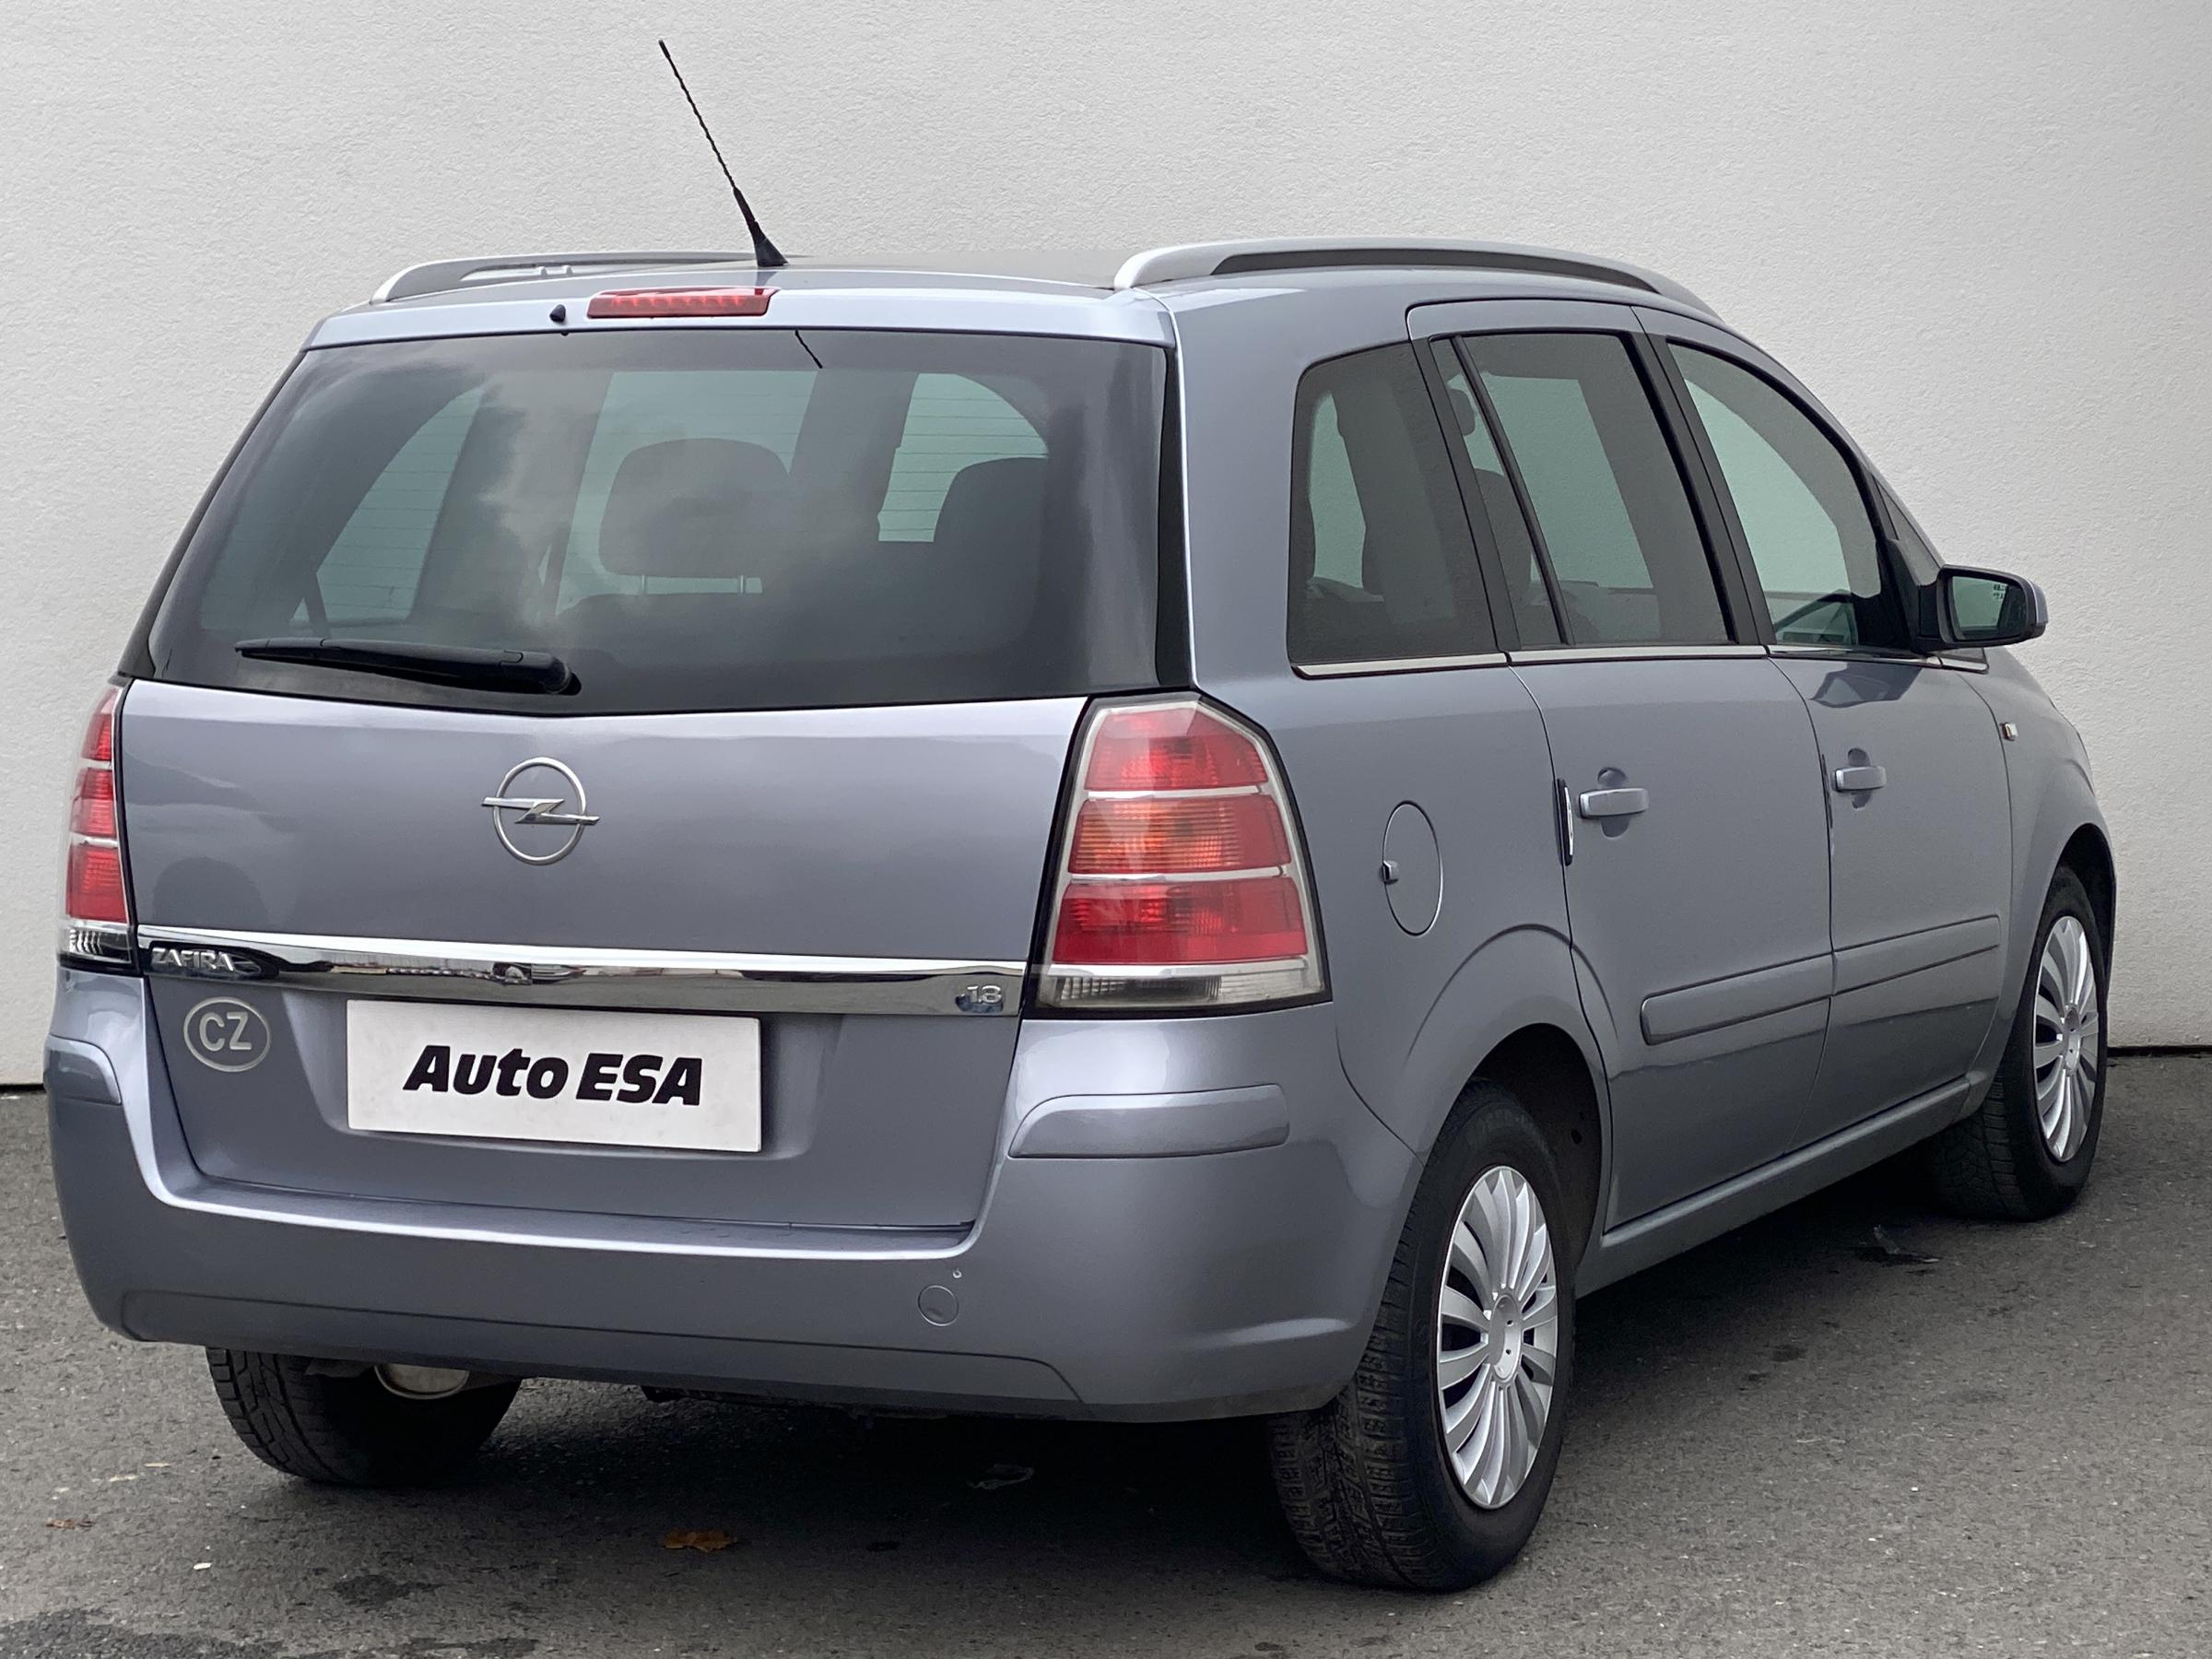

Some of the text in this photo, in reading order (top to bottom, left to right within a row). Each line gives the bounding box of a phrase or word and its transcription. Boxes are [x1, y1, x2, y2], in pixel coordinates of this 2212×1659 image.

[150, 947, 234, 971] ZAFIRA
[966, 984, 1003, 1004] 1.8
[198, 1010, 253, 1053] CZ
[402, 1044, 702, 1106] Auto ESA
